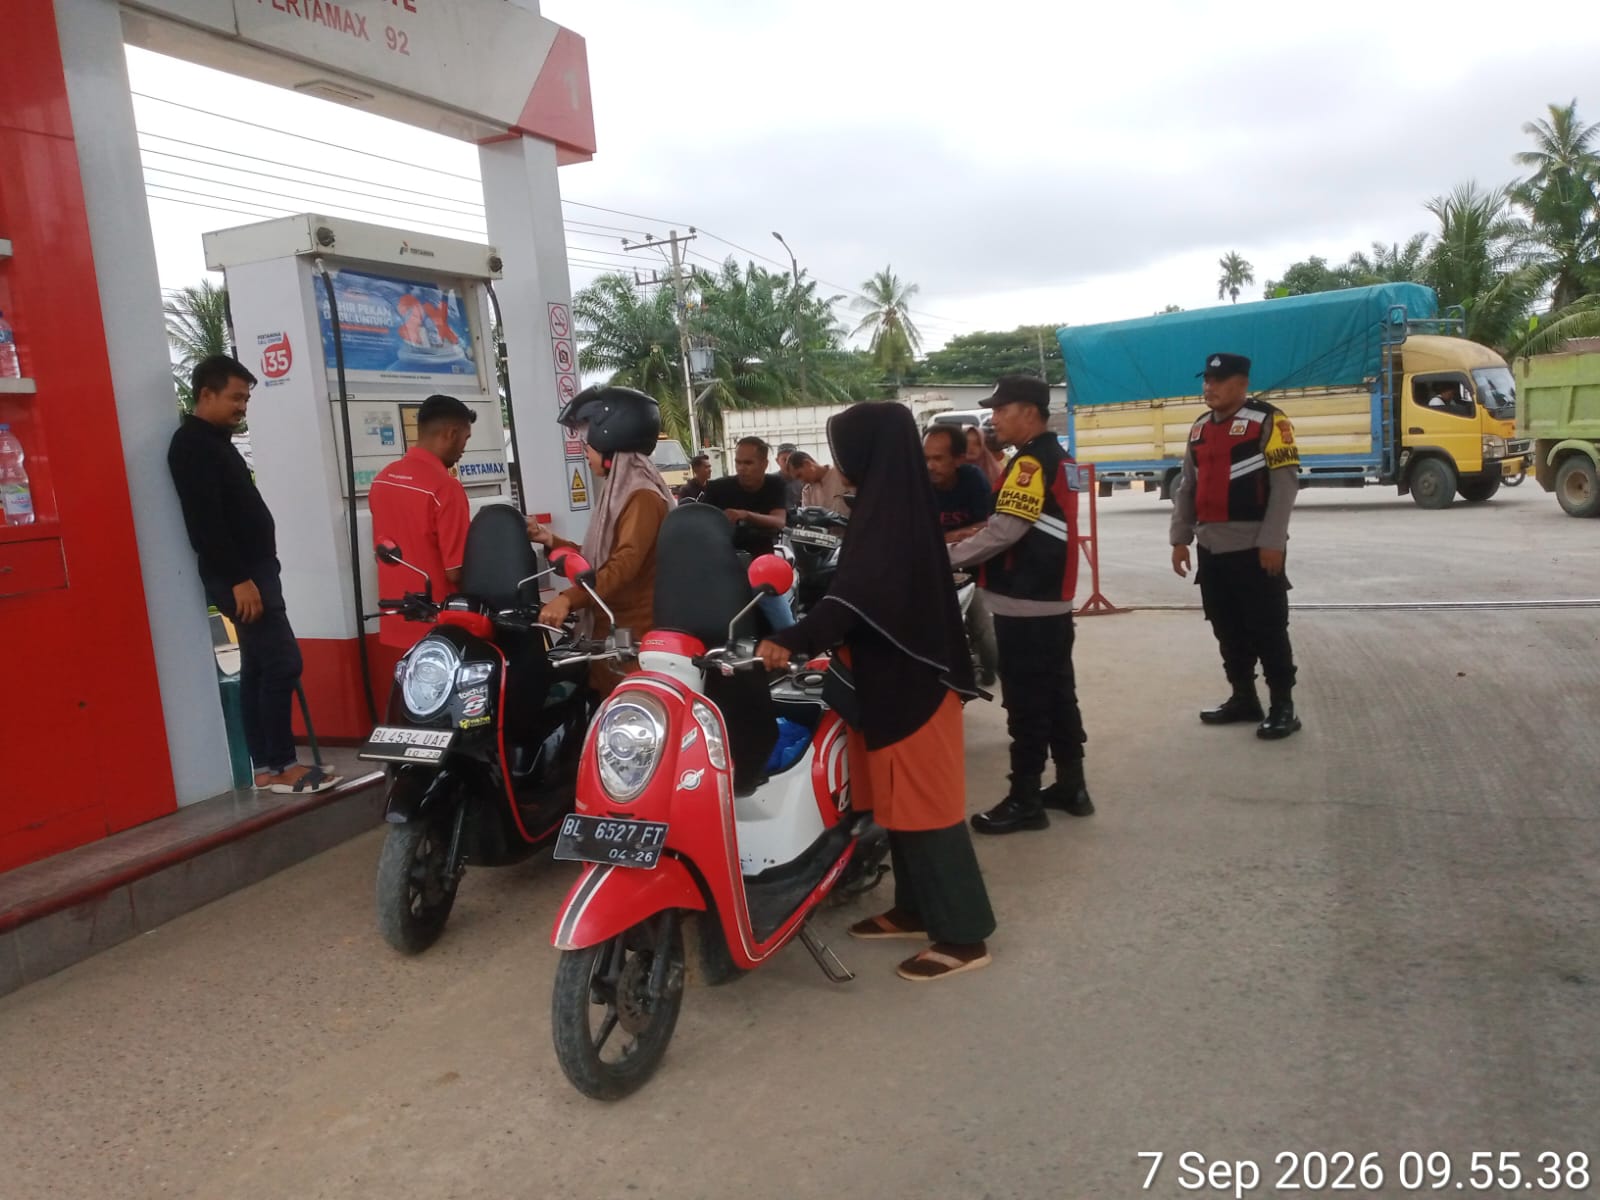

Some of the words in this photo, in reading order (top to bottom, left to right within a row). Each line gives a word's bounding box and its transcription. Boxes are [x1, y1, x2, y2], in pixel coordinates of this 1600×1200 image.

[256, 0, 370, 41] ERTAMAX
[385, 25, 410, 56] 92
[262, 349, 289, 374] 135
[460, 462, 505, 476] PERTAMAX
[372, 730, 386, 742] BL
[388, 732, 419, 744] 4534
[423, 734, 448, 746] UAF
[563, 819, 581, 836] BL
[594, 822, 637, 841] 6527
[640, 826, 663, 845] FT
